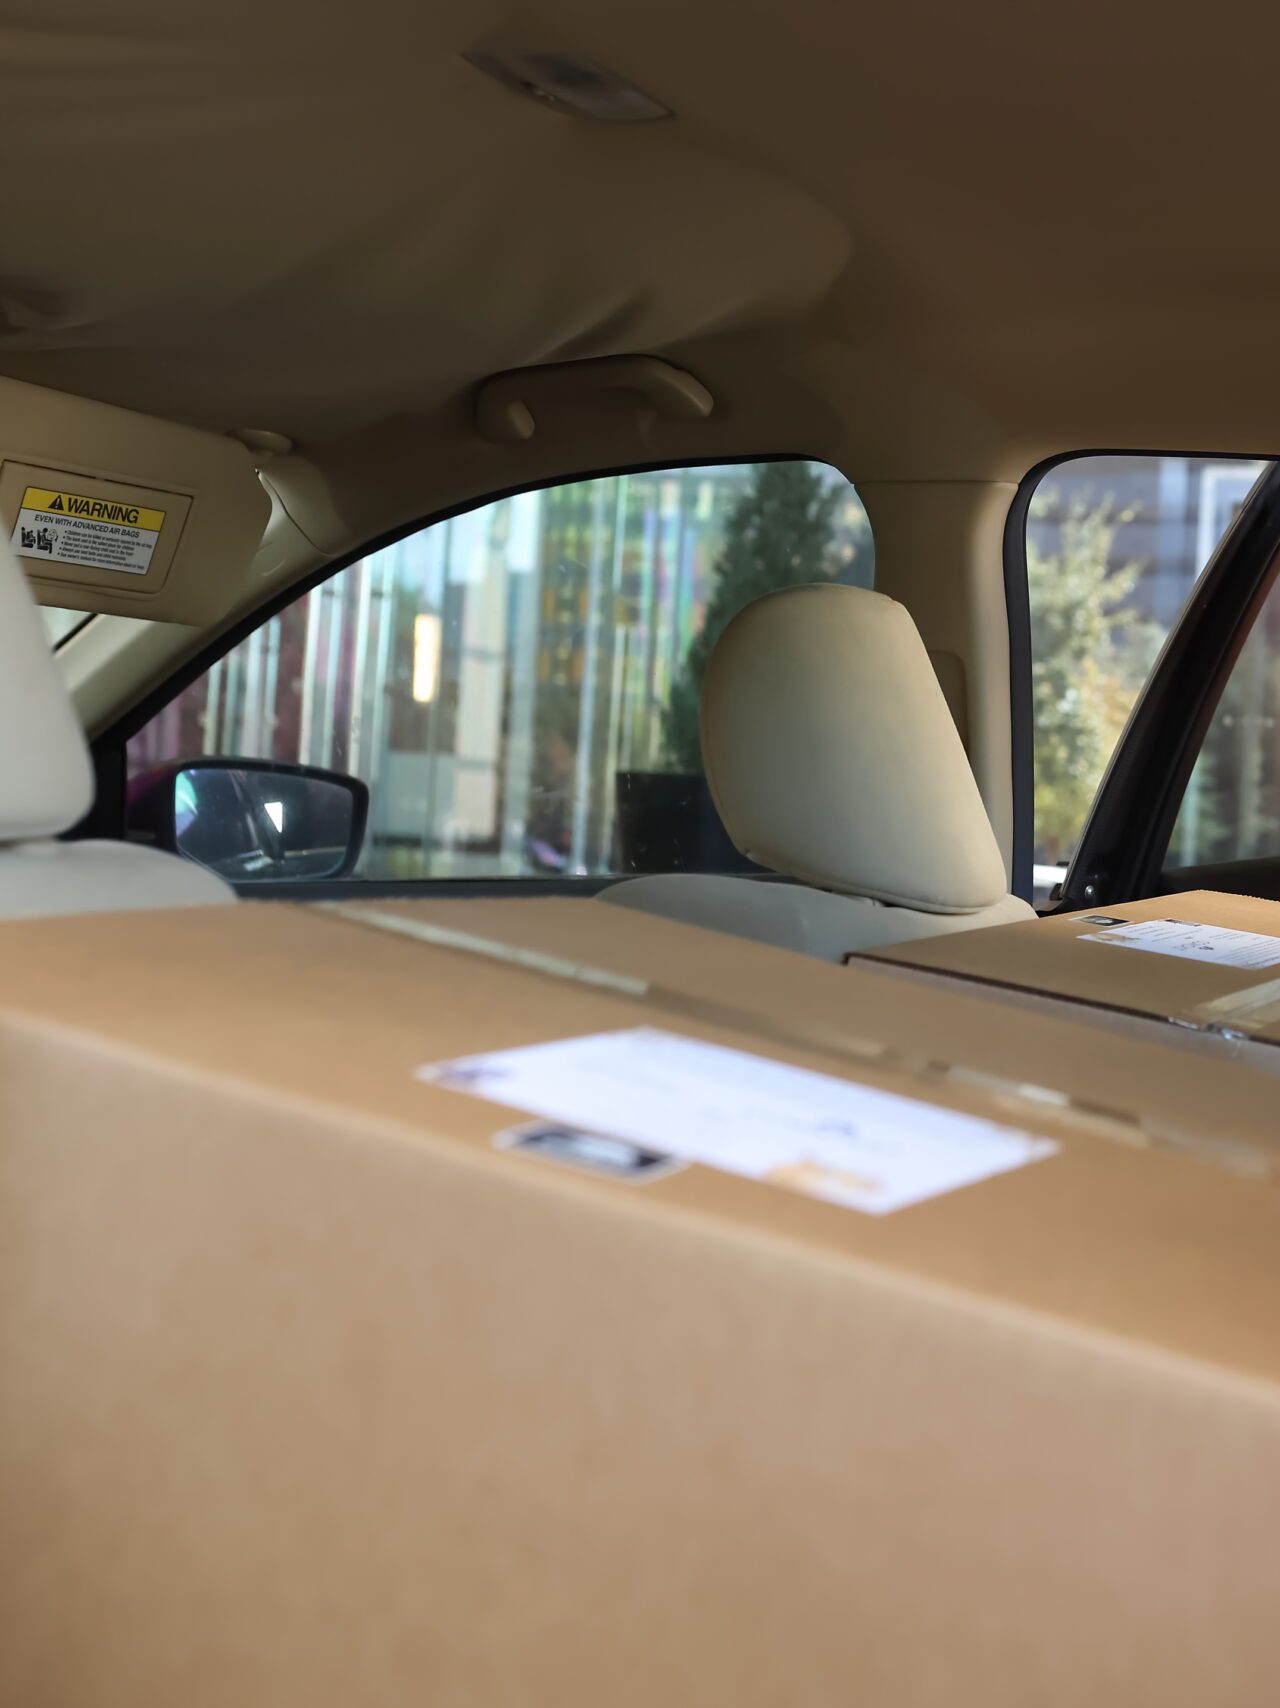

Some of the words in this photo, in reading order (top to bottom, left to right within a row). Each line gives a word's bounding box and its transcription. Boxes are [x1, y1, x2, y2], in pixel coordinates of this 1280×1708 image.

[68, 498, 139, 524] WARNING
[35, 514, 54, 524] EVEN
[54, 517, 72, 527] WITH
[72, 520, 109, 533] ADVANCED
[109, 527, 121, 535] AIR
[121, 529, 140, 539] BAGS
